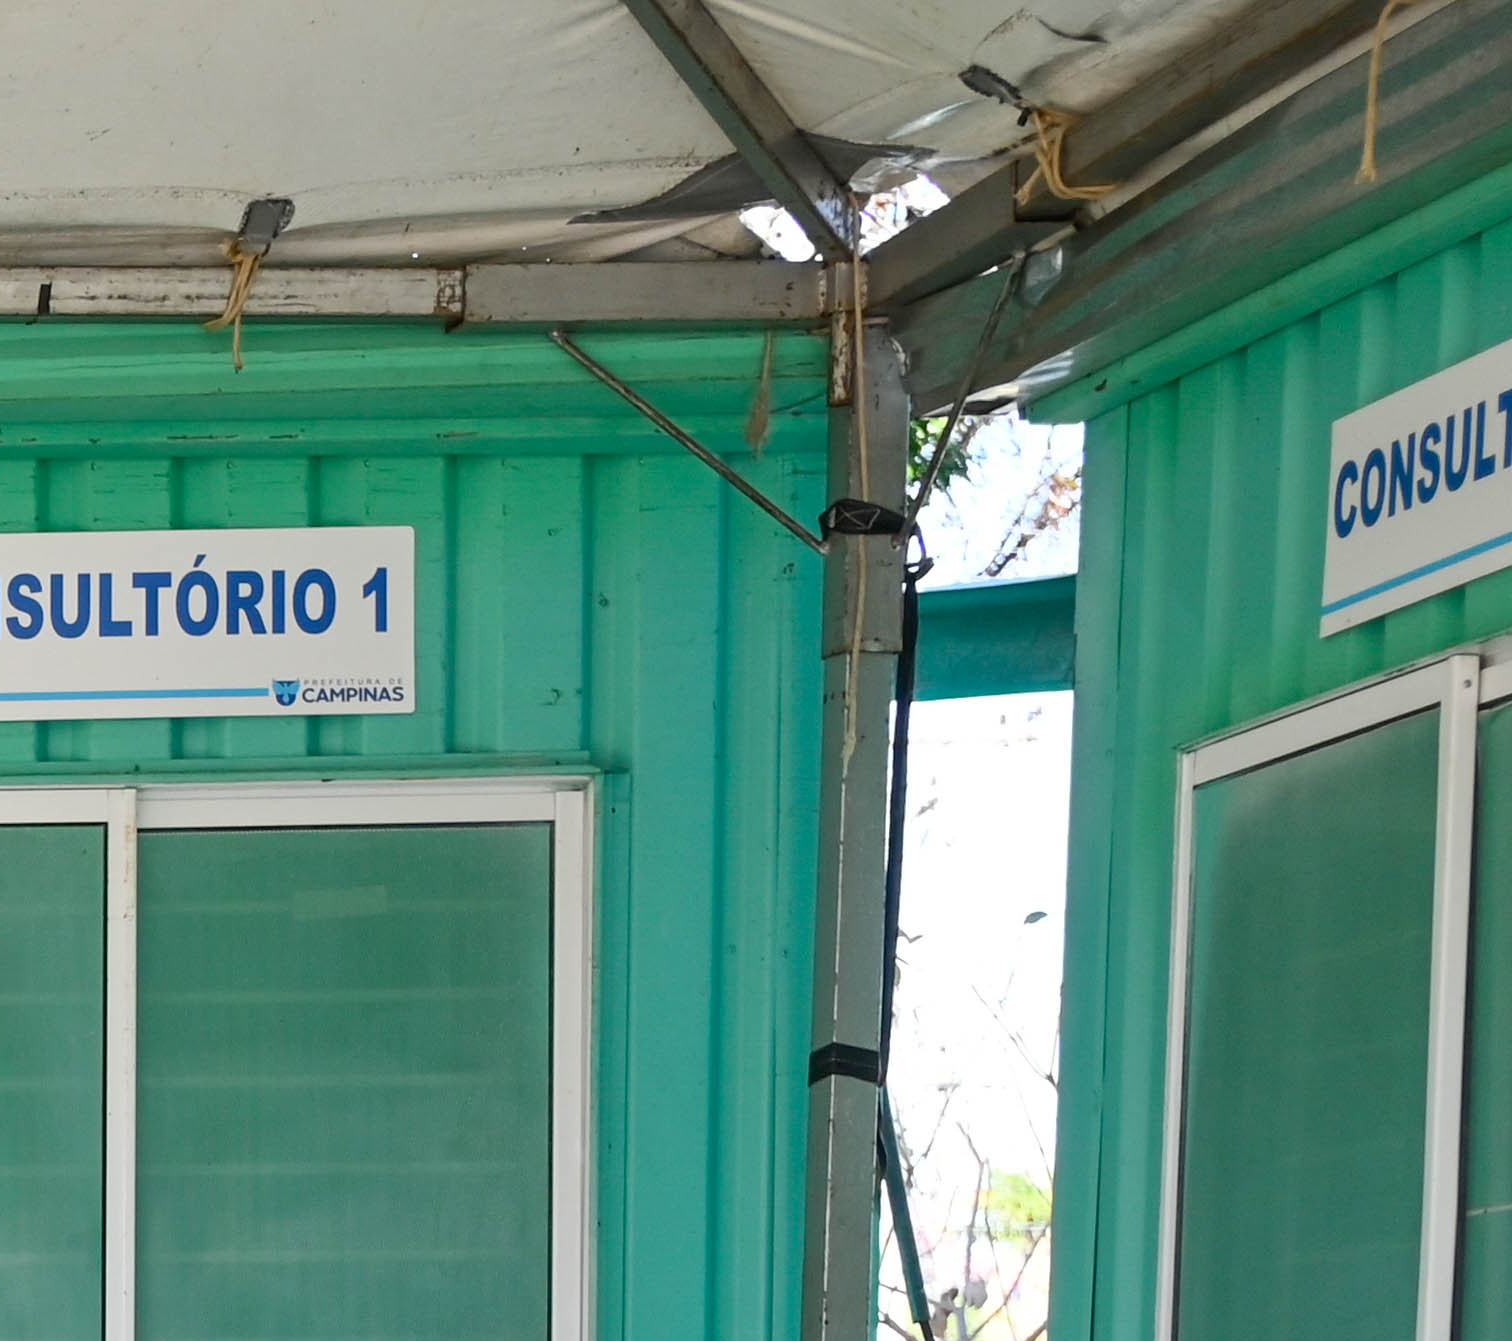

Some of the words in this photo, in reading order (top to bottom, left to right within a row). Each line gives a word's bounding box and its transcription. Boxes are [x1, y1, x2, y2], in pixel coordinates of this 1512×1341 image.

[362, 567, 388, 633] 1
[304, 678, 380, 686] PREFEITURA
[388, 677, 404, 685] DE
[302, 685, 405, 703] CAMPINAS
